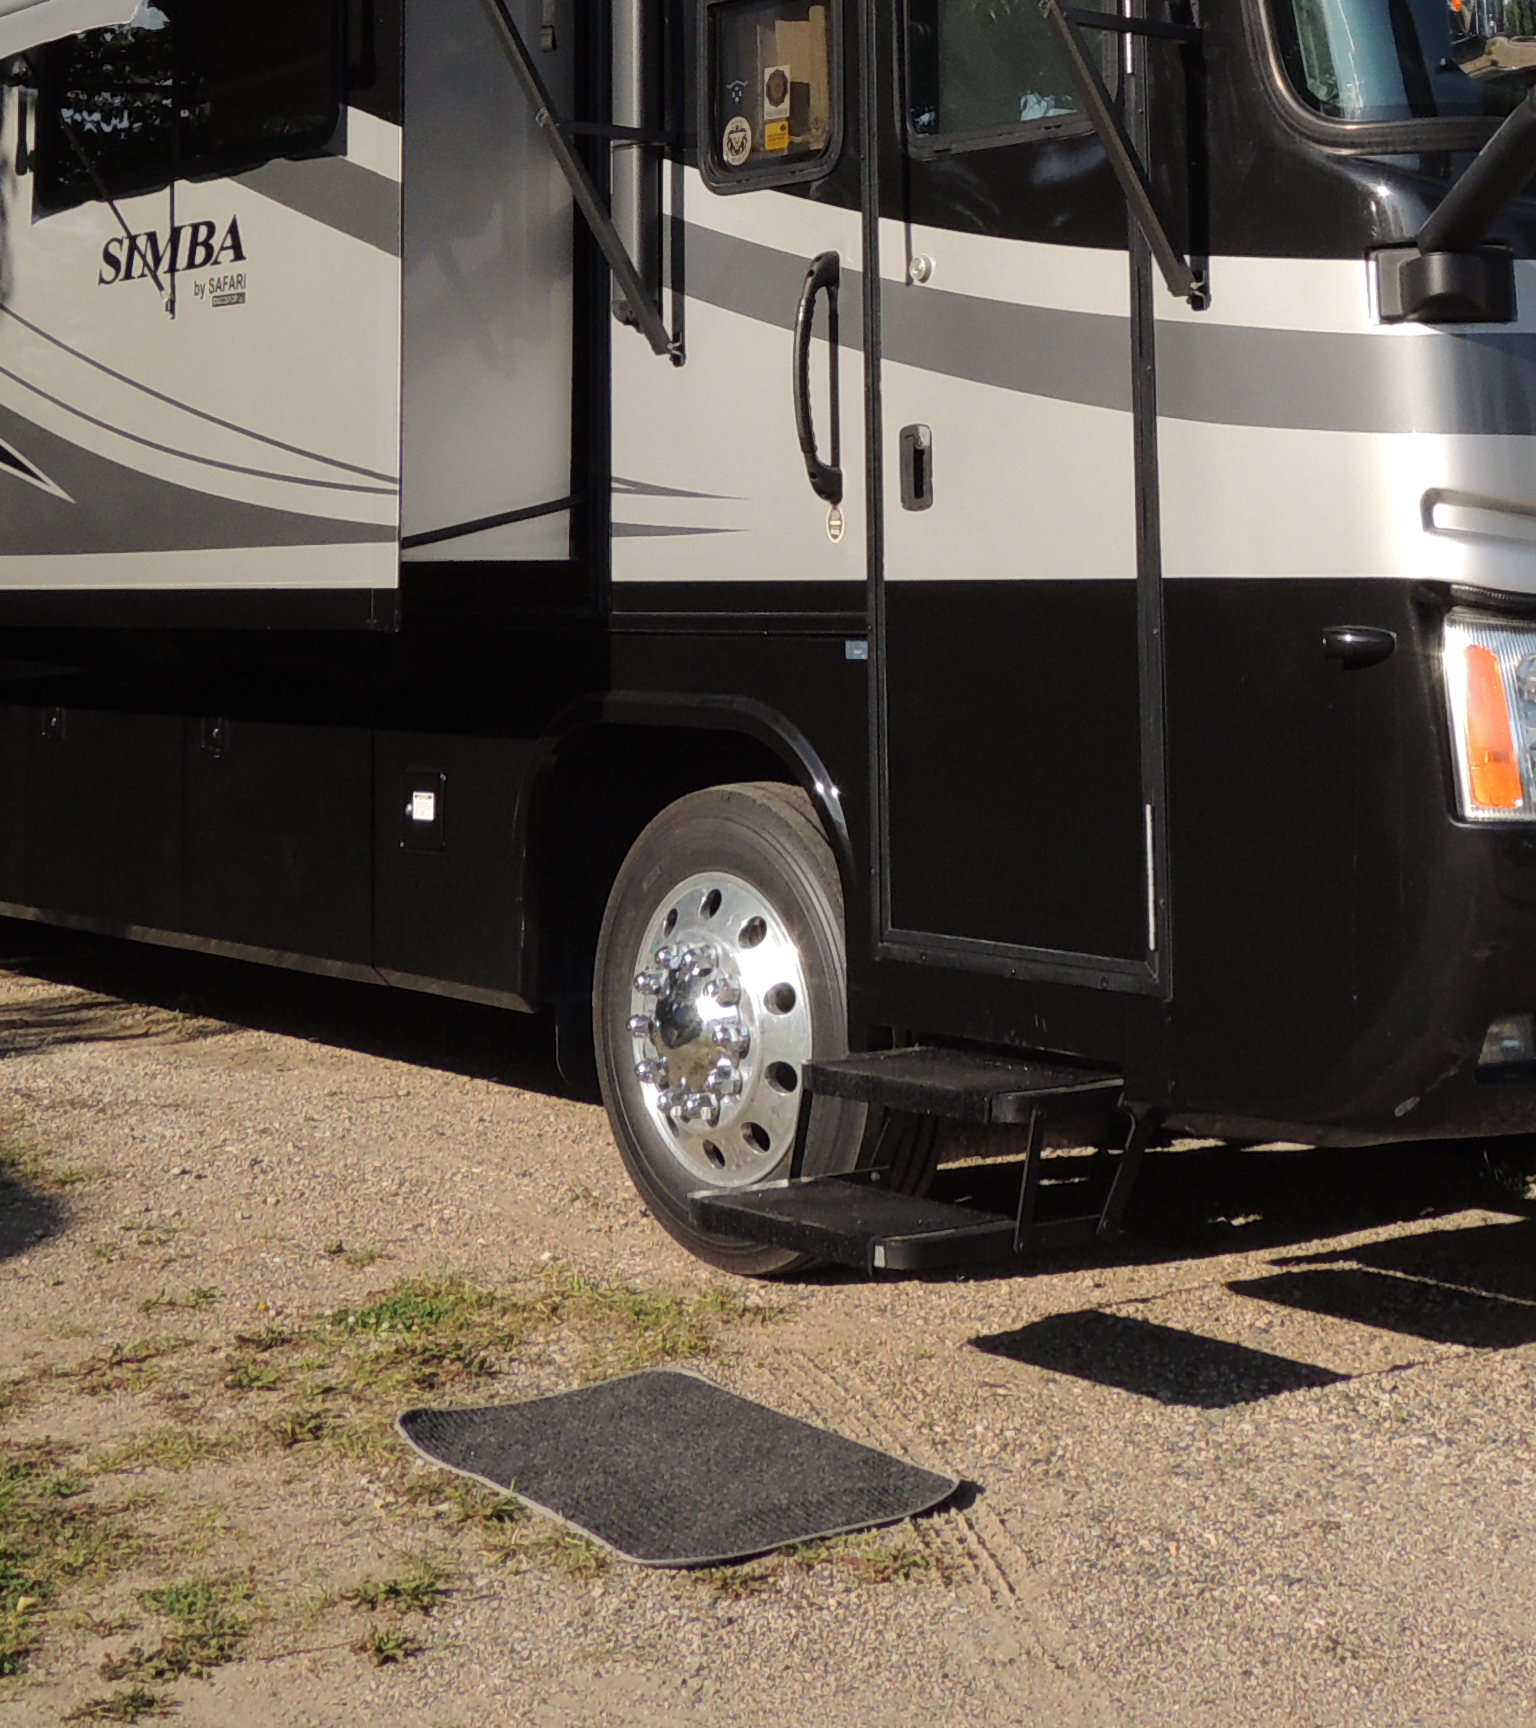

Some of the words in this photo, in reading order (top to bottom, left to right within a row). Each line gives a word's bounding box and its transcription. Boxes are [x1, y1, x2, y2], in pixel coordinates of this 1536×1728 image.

[98, 214, 247, 286] SIMBA
[194, 279, 206, 300] by
[208, 272, 247, 294] SAFARI
